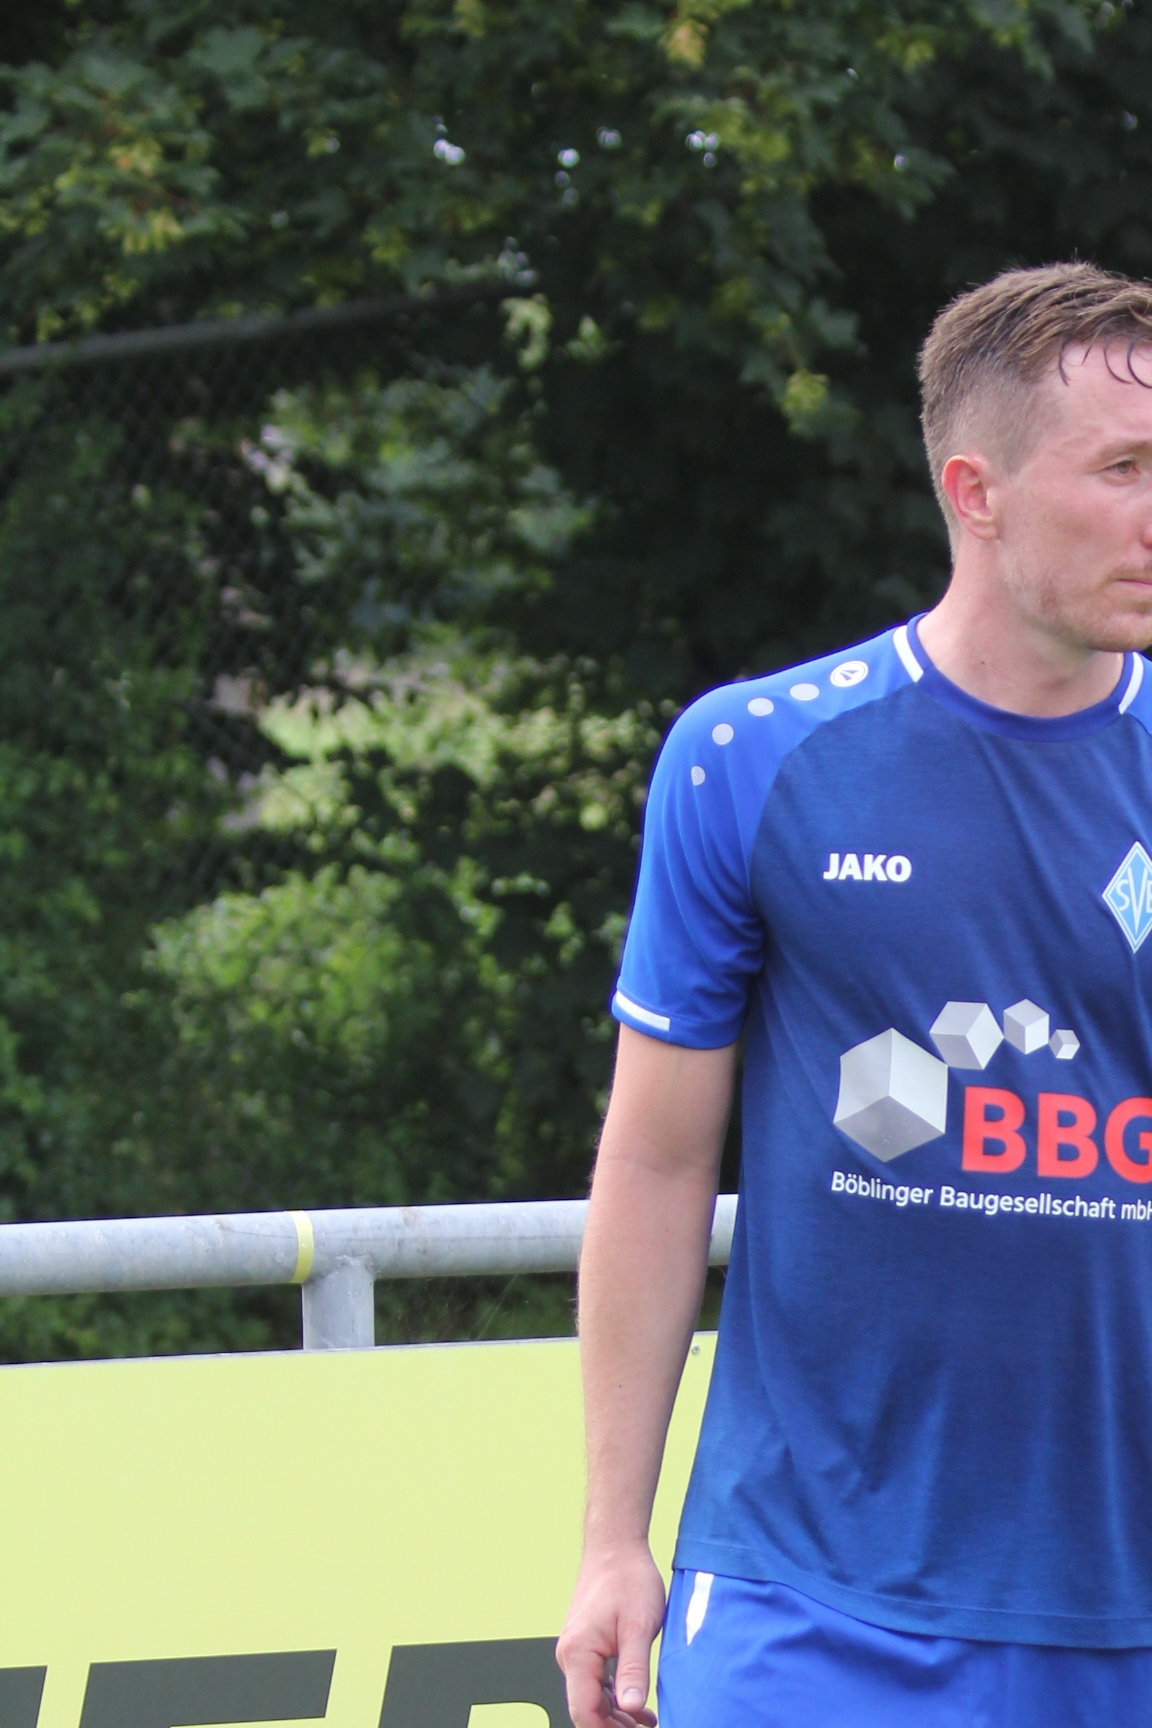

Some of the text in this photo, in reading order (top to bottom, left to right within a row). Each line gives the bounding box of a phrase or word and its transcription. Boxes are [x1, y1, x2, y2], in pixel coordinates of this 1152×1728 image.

[823, 853, 912, 882] JAKO
[831, 1171, 934, 1207] Böblinger
[940, 1186, 1117, 1219] Baugesellschaft
